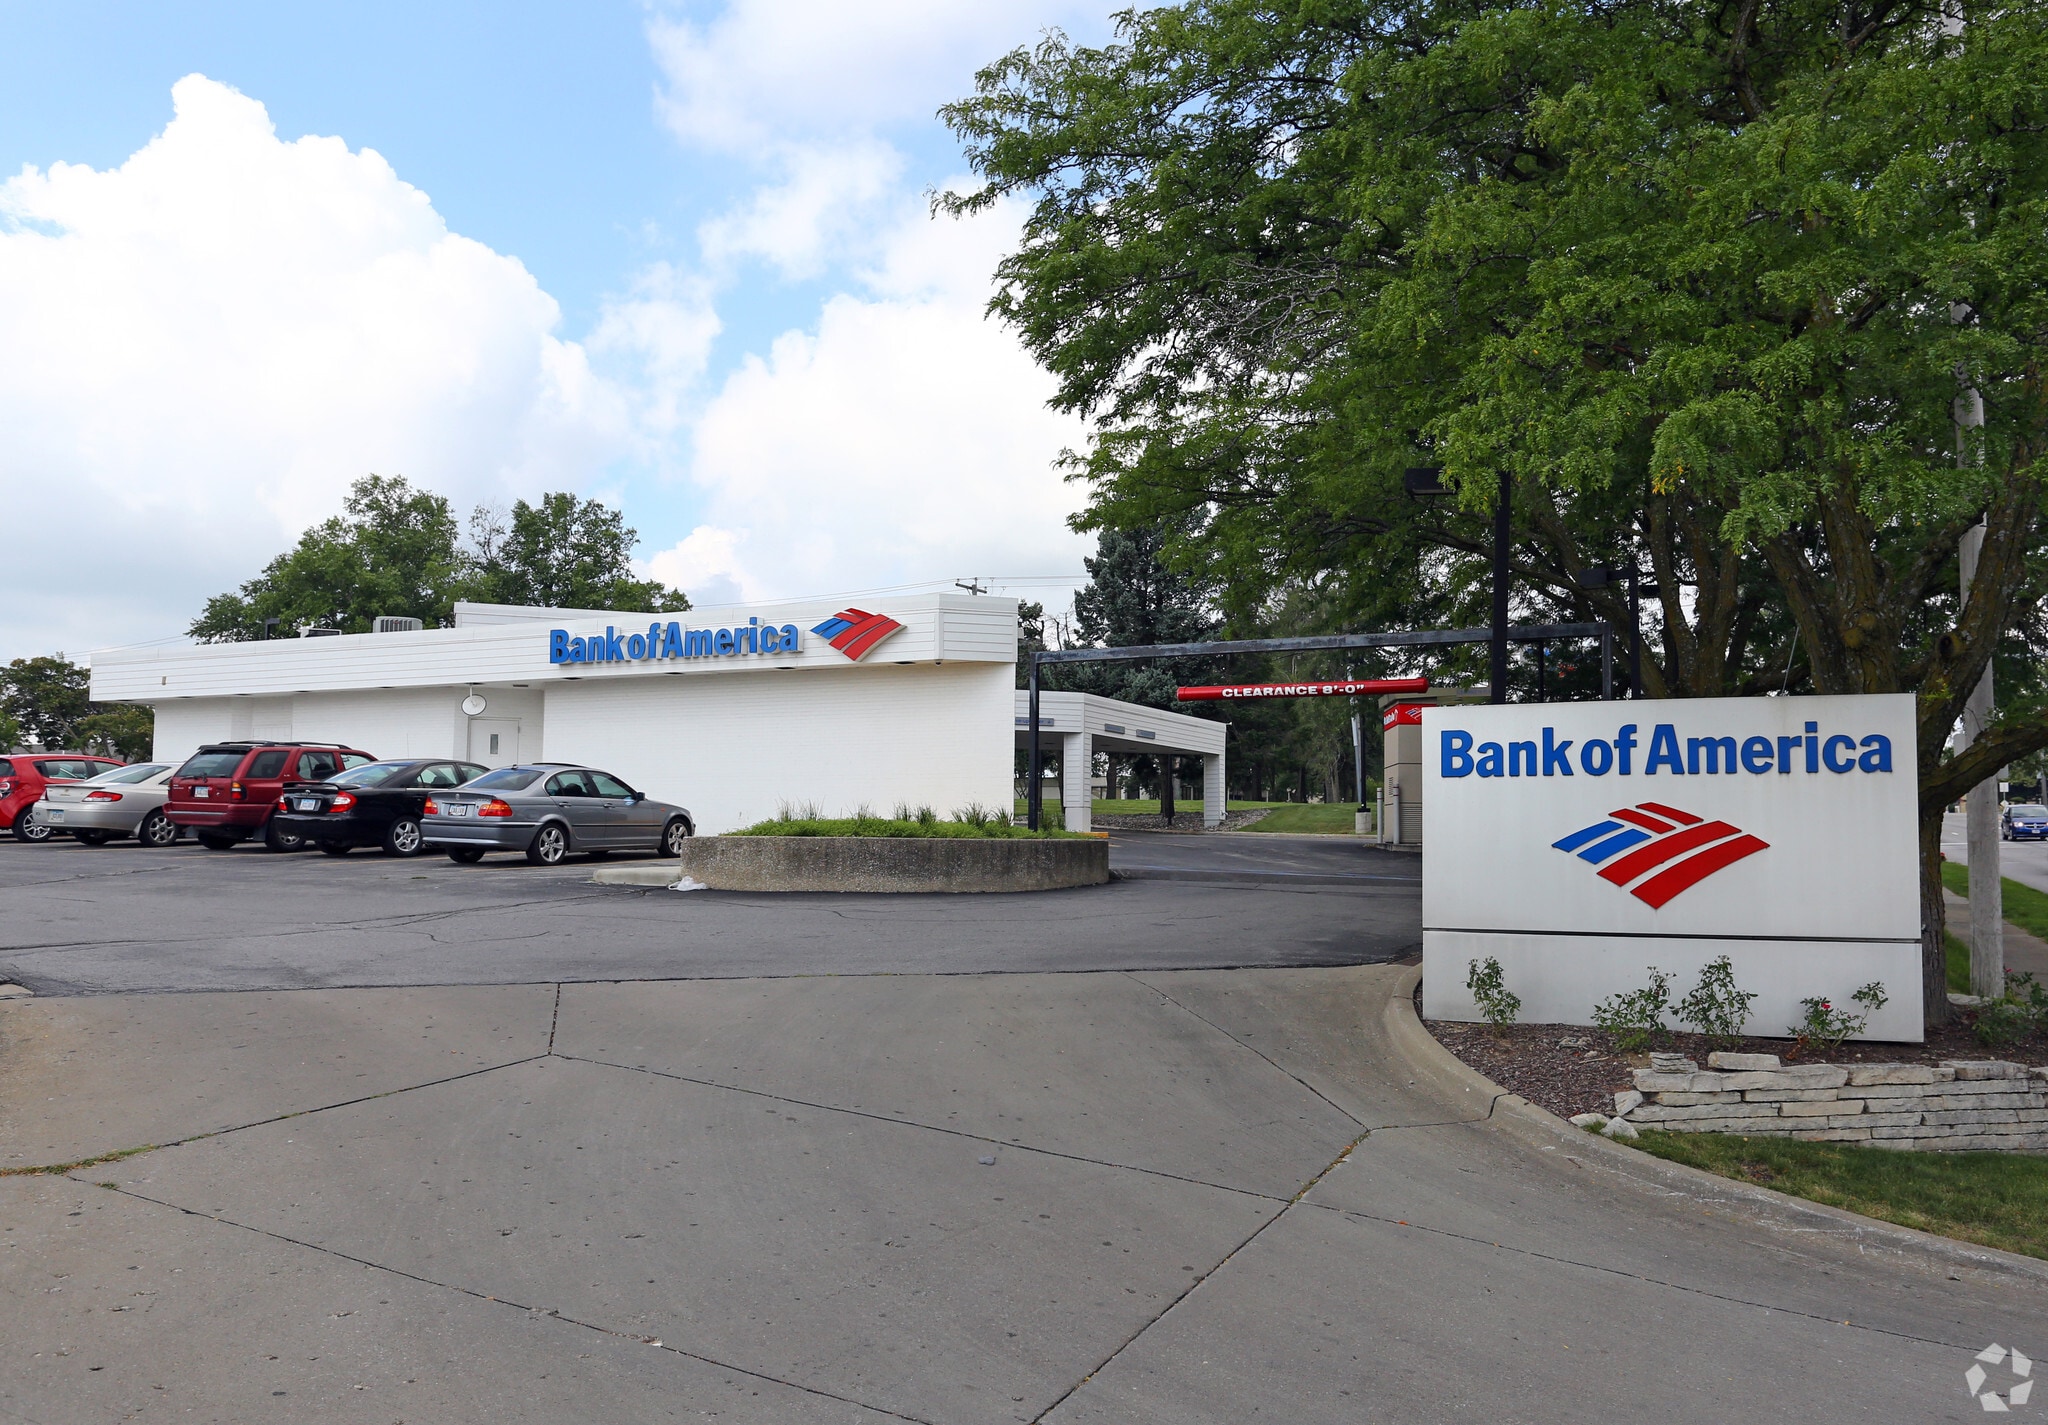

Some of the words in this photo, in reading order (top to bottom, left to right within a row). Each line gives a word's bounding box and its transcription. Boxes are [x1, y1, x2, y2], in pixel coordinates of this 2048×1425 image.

[549, 625, 625, 664] Bank
[627, 622, 663, 660] of
[663, 616, 799, 658] America
[1221, 685, 1318, 698] CLEARANCE
[1440, 726, 1575, 778] Bank
[1580, 723, 1638, 777] of
[1644, 720, 1894, 775] America
